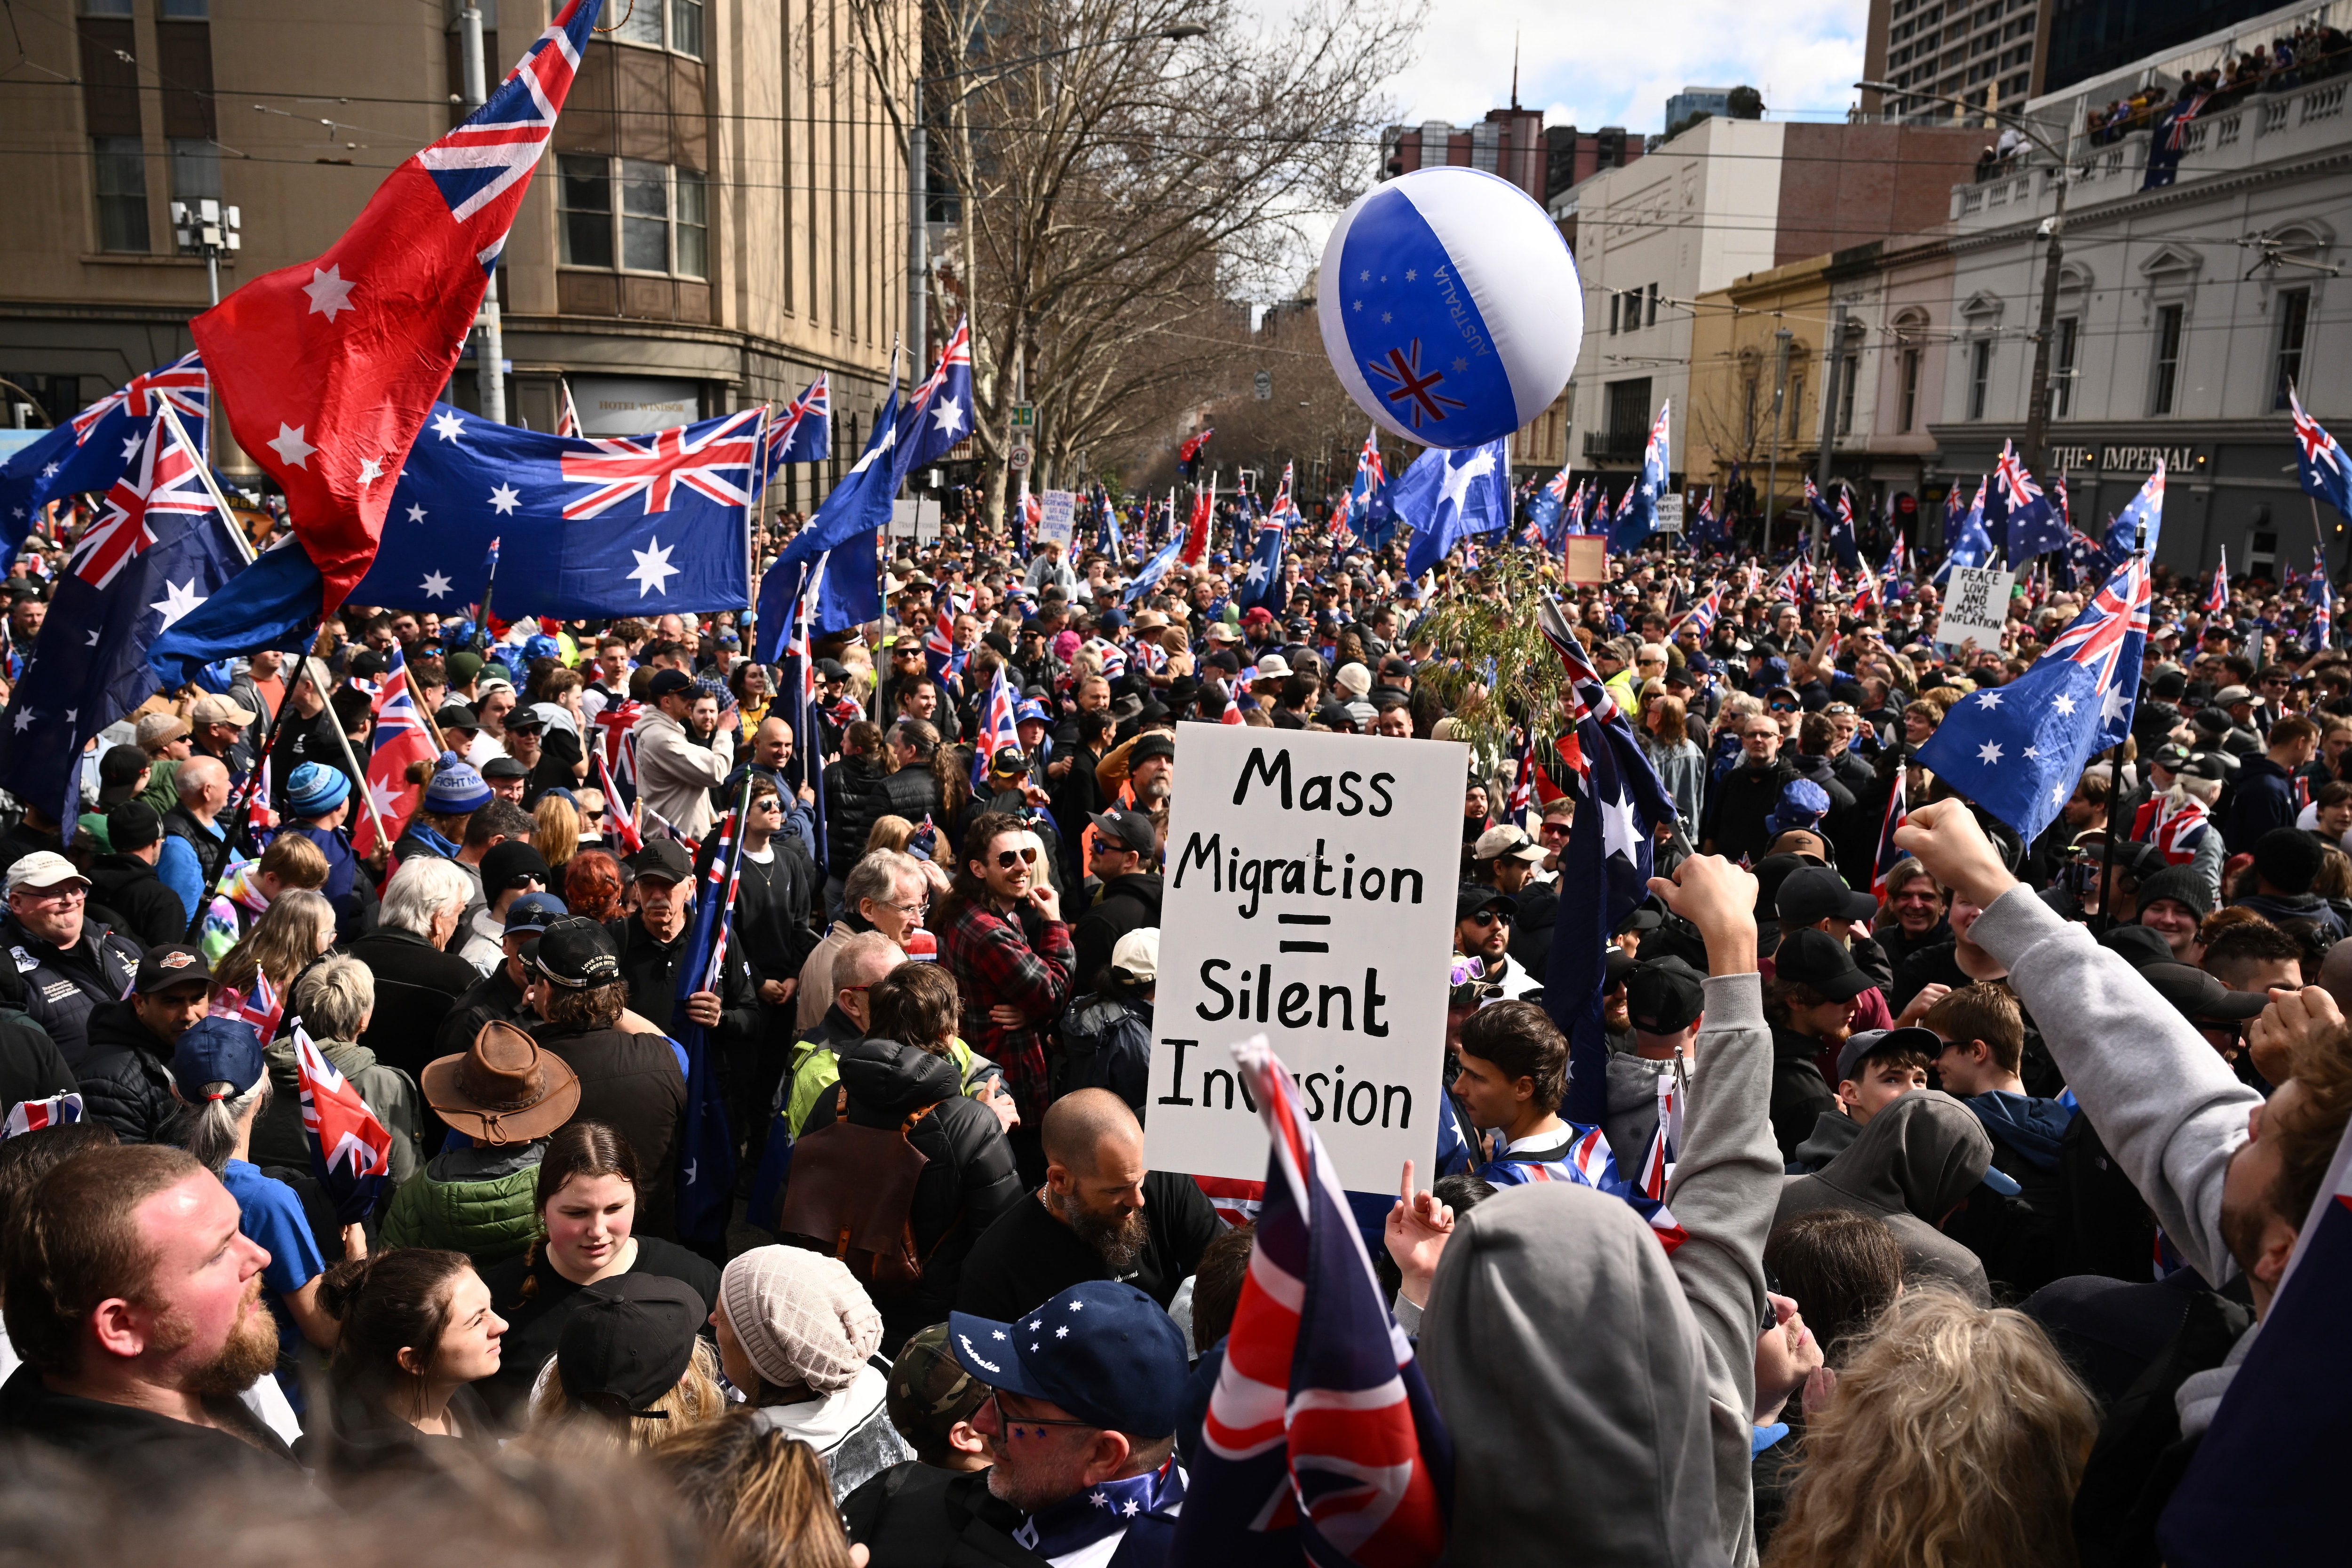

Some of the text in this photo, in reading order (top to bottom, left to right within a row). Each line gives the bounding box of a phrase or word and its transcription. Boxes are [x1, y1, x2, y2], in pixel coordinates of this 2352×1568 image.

[1434, 265, 1490, 357] AUSTRALIA
[599, 401, 684, 412] HOTEL WINDSOR
[1014, 453, 1027, 462] 40
[2052, 447, 2195, 472] THE IMPERIAL
[1961, 569, 2001, 585] PEACE
[1963, 583, 1989, 595] LOVE
[1963, 594, 1986, 605] AND
[1955, 604, 1987, 617] MASS
[1944, 613, 2002, 630] INFLATION
[434, 776, 465, 787] FIGHT
[1232, 748, 1395, 817] Mass
[1173, 832, 1422, 919] Migration
[581, 959, 595, 971] LOVE
[591, 962, 603, 971] BEER
[1196, 959, 1388, 1037] Silent
[1158, 1038, 1412, 1129] Insion
[959, 1334, 1000, 1372] Australia
